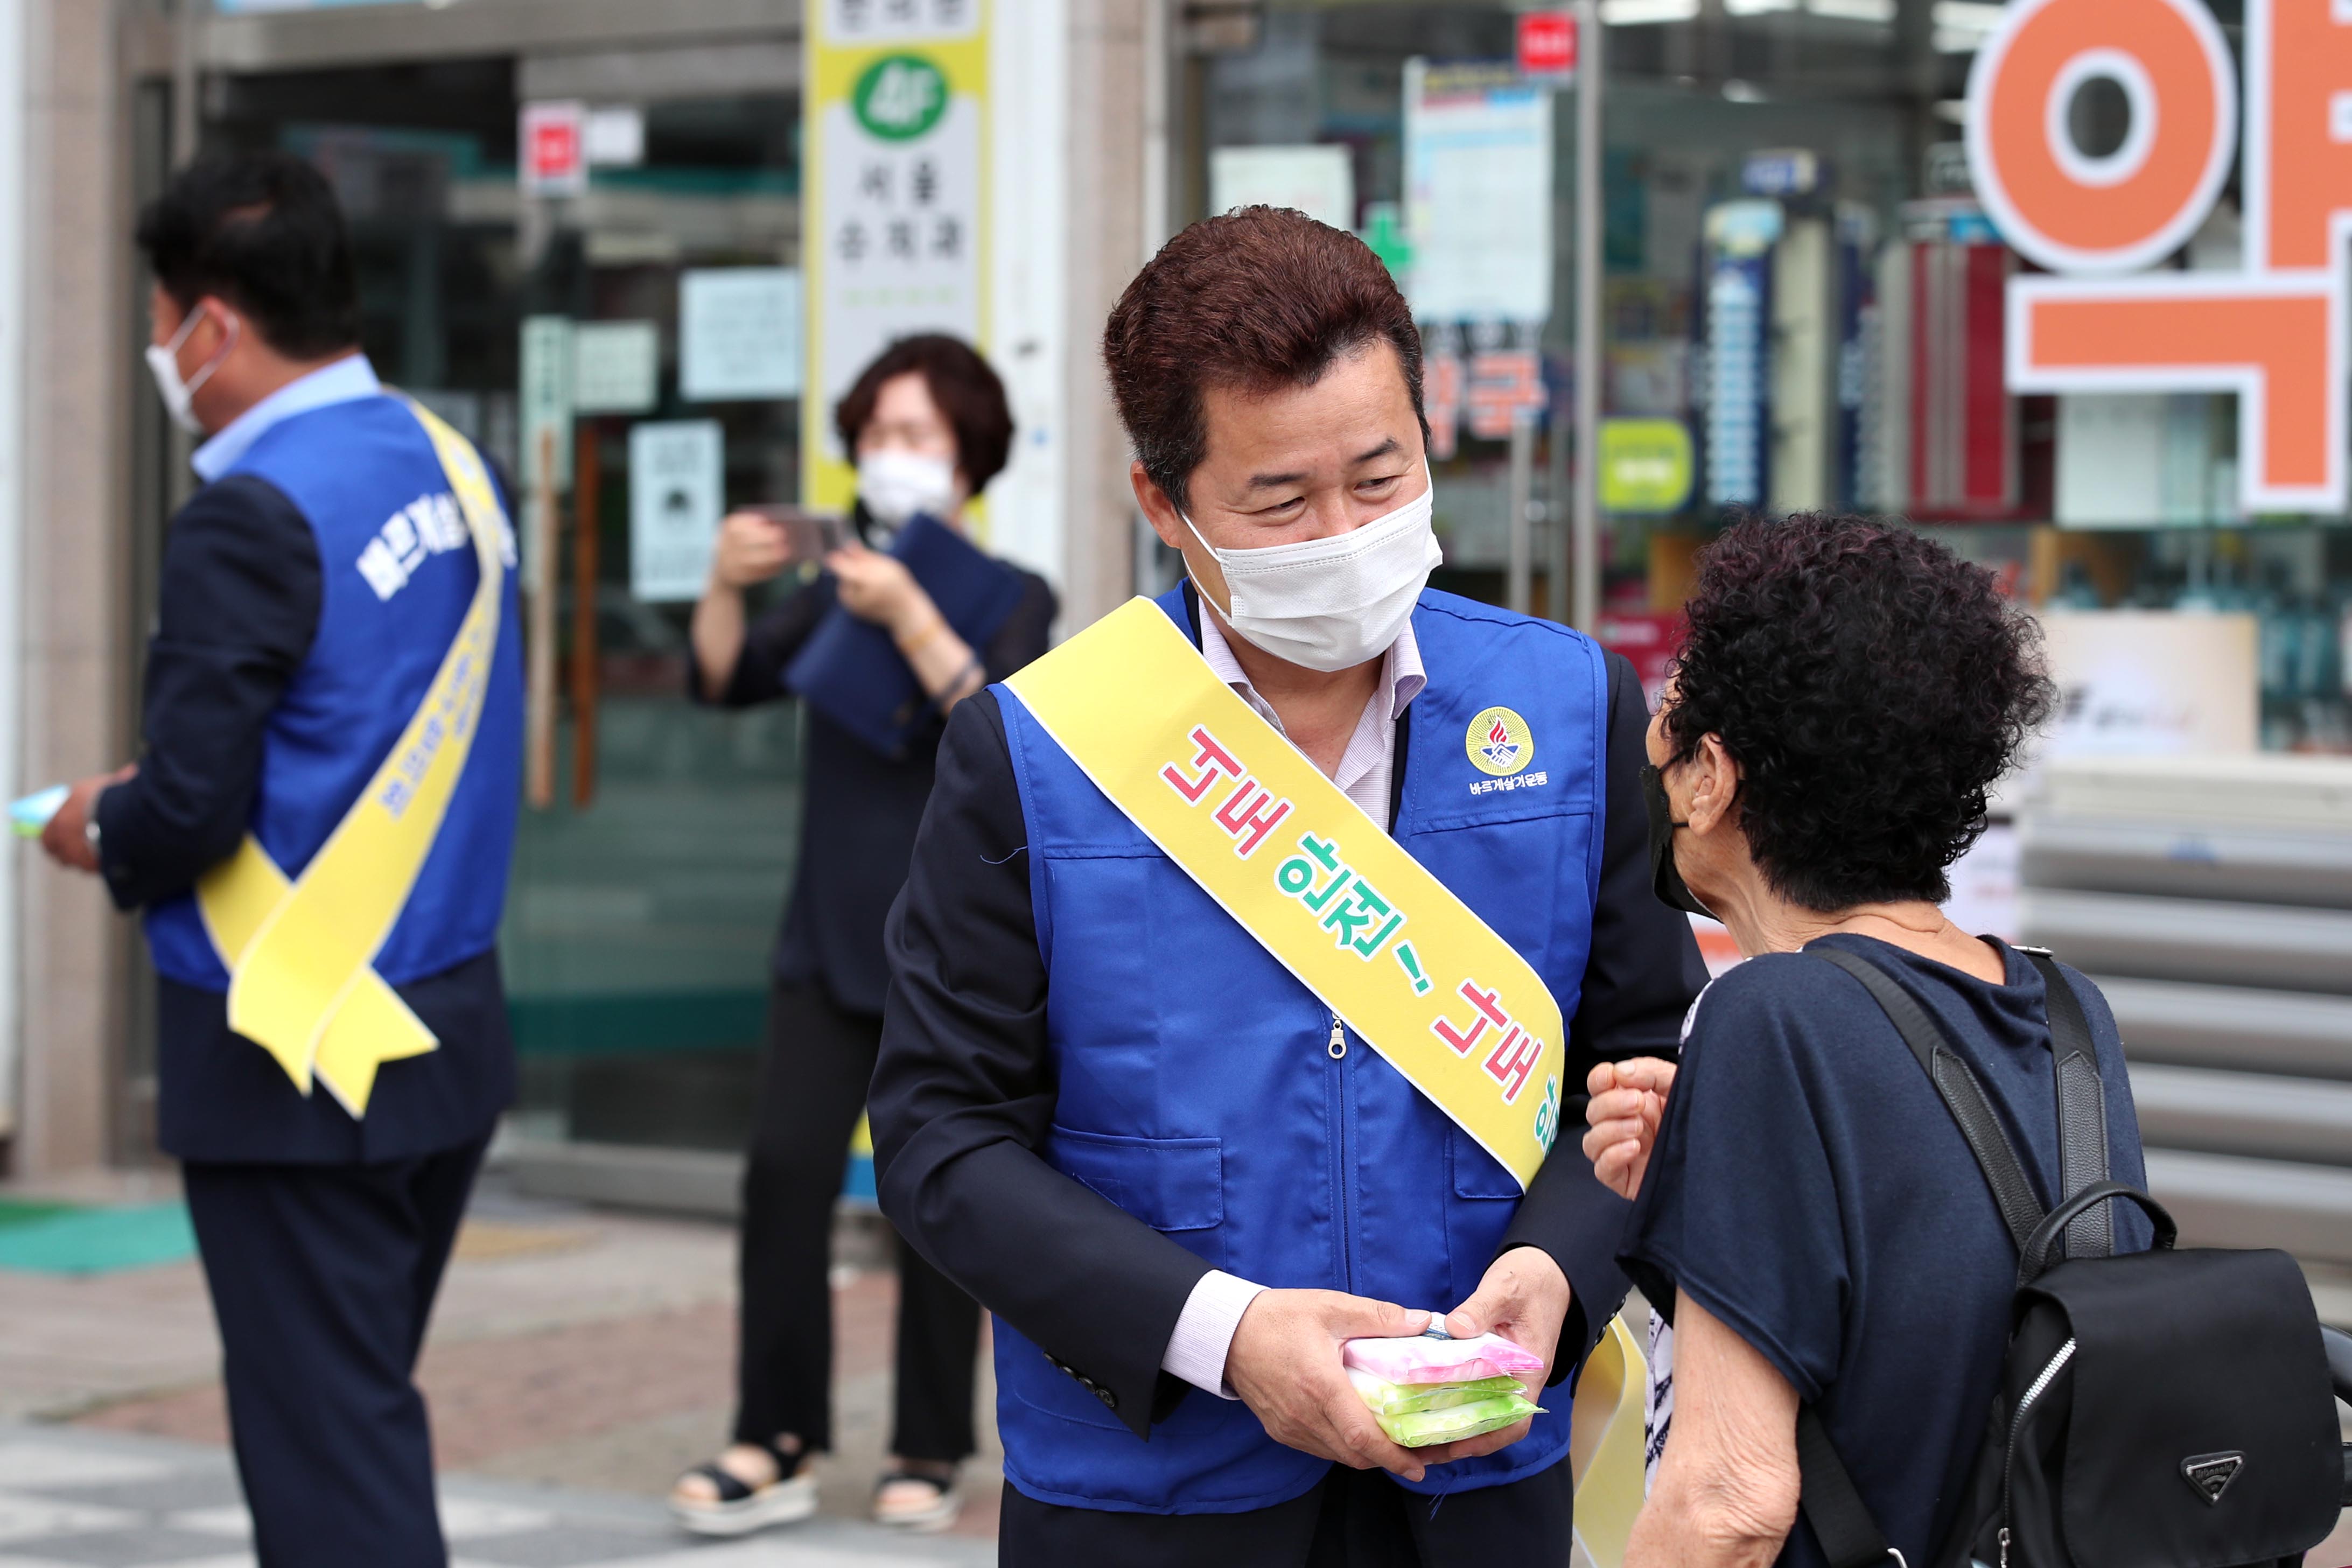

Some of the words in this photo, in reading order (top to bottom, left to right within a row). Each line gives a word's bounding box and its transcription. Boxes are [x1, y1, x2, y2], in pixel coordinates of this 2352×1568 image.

[865, 58, 942, 130] 4F
[1468, 771, 1549, 796] 바르게살기운동
[1159, 725, 1294, 860] 너도
[1275, 831, 1432, 996] 안전!
[1431, 978, 1544, 1104] 나도
